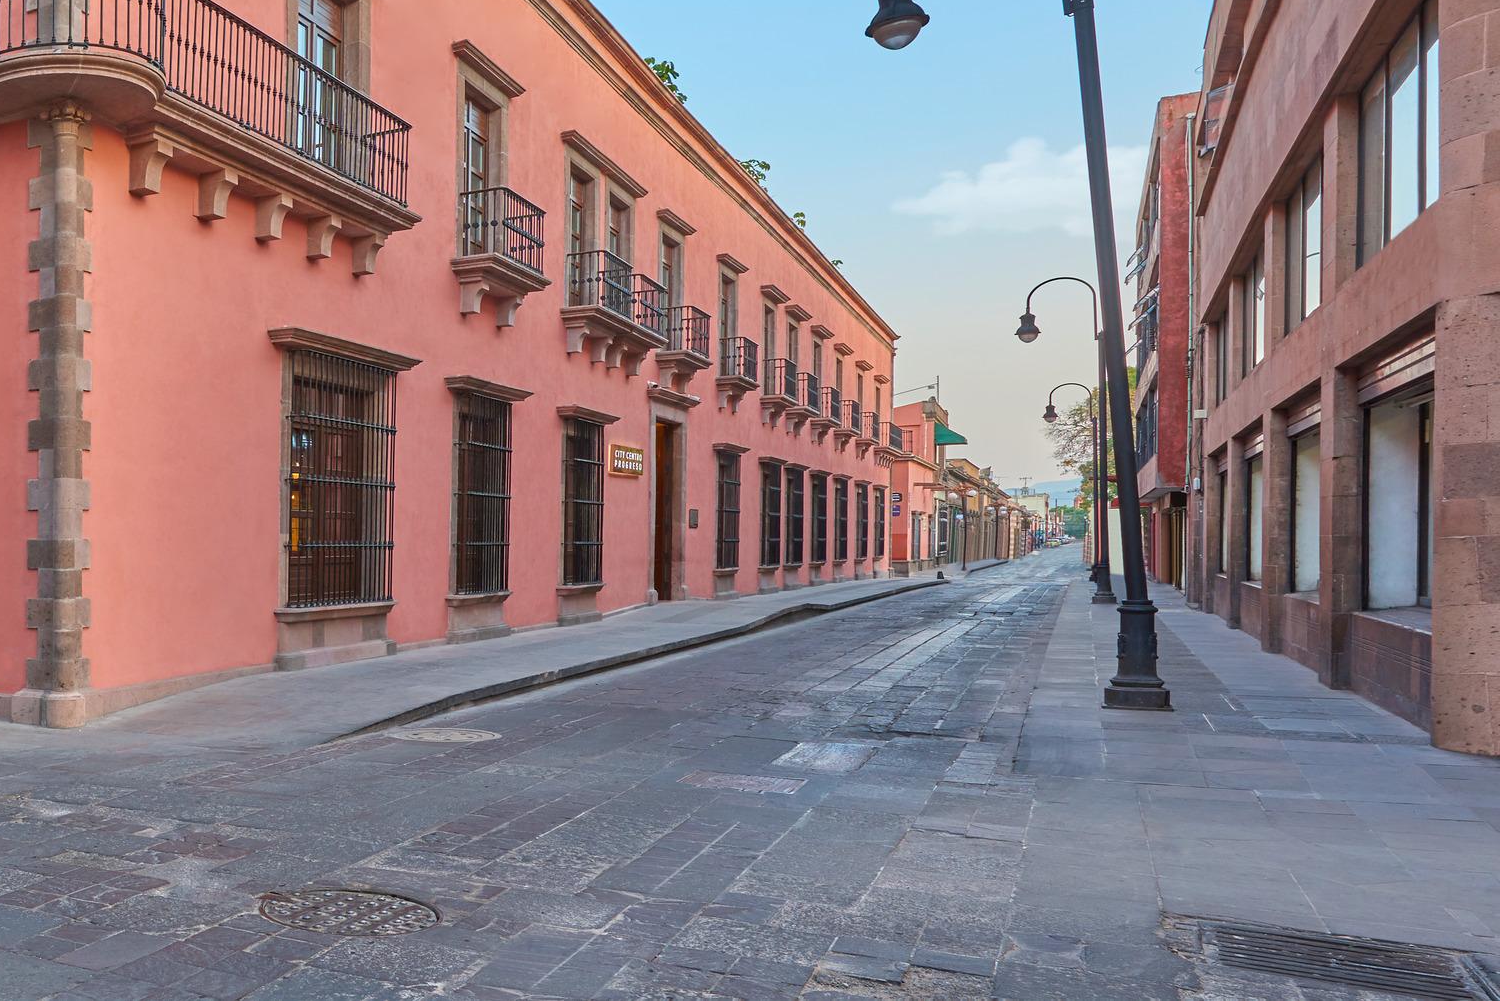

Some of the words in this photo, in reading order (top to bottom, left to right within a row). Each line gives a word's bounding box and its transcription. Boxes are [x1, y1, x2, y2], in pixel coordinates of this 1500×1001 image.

[614, 450, 626, 459] CITY
[626, 451, 643, 462] CENTRO
[614, 459, 643, 471] PROGRESO
